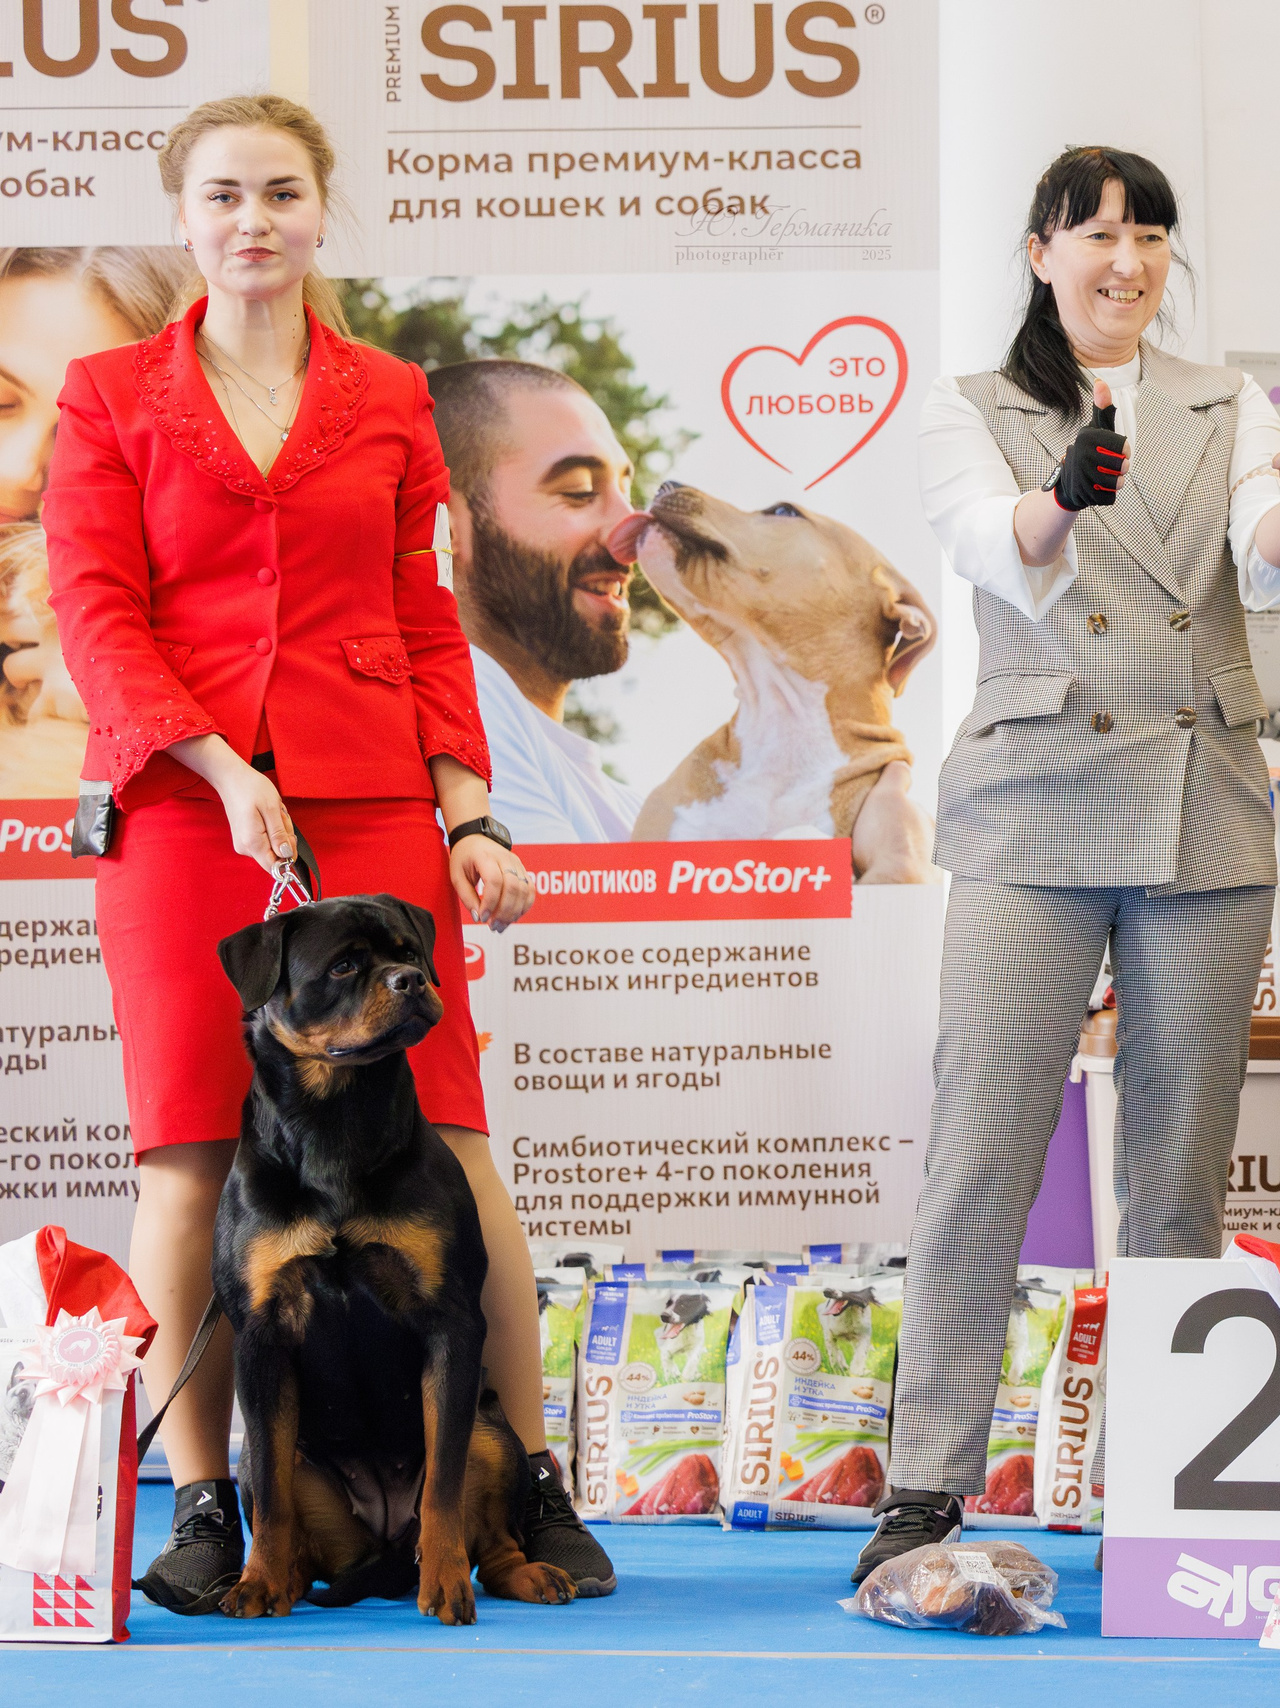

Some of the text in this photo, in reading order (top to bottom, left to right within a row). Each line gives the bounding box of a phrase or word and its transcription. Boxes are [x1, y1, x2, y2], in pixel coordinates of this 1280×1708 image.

[0, 0, 188, 78] US
[386, 5, 401, 103] PREMIUM
[386, 144, 863, 180] Корма премиум-класса
[389, 187, 771, 223] для кошек и собак
[828, 356, 886, 377] ЭТО
[745, 393, 875, 416] ЛЮБОВЬ
[667, 858, 832, 894] ProStor+
[512, 943, 812, 968] Высокое содержание
[512, 970, 819, 995] мясных ингредиентов
[513, 1042, 832, 1068] В составе натуральные
[513, 1071, 721, 1093] овощи и ягоды
[512, 1131, 892, 1160] Симбиотический комплекс
[512, 1159, 873, 1186] Prostore+ 4-го поколения
[514, 1182, 880, 1214] для поддержки иммунной
[1262, 1221, 1272, 1231] и
[591, 1335, 617, 1347] ADULT
[1073, 1330, 1098, 1346] ADULT
[791, 1350, 816, 1361] 44%
[794, 1376, 837, 1391] ИНДЕЙКА
[801, 1386, 825, 1397] УТКА
[740, 1356, 780, 1487] SIRIUS
[585, 1375, 614, 1506] SIRIUS
[1051, 1375, 1094, 1510] SIRIUS
[737, 1508, 817, 1523] ADULT SIRIUS
